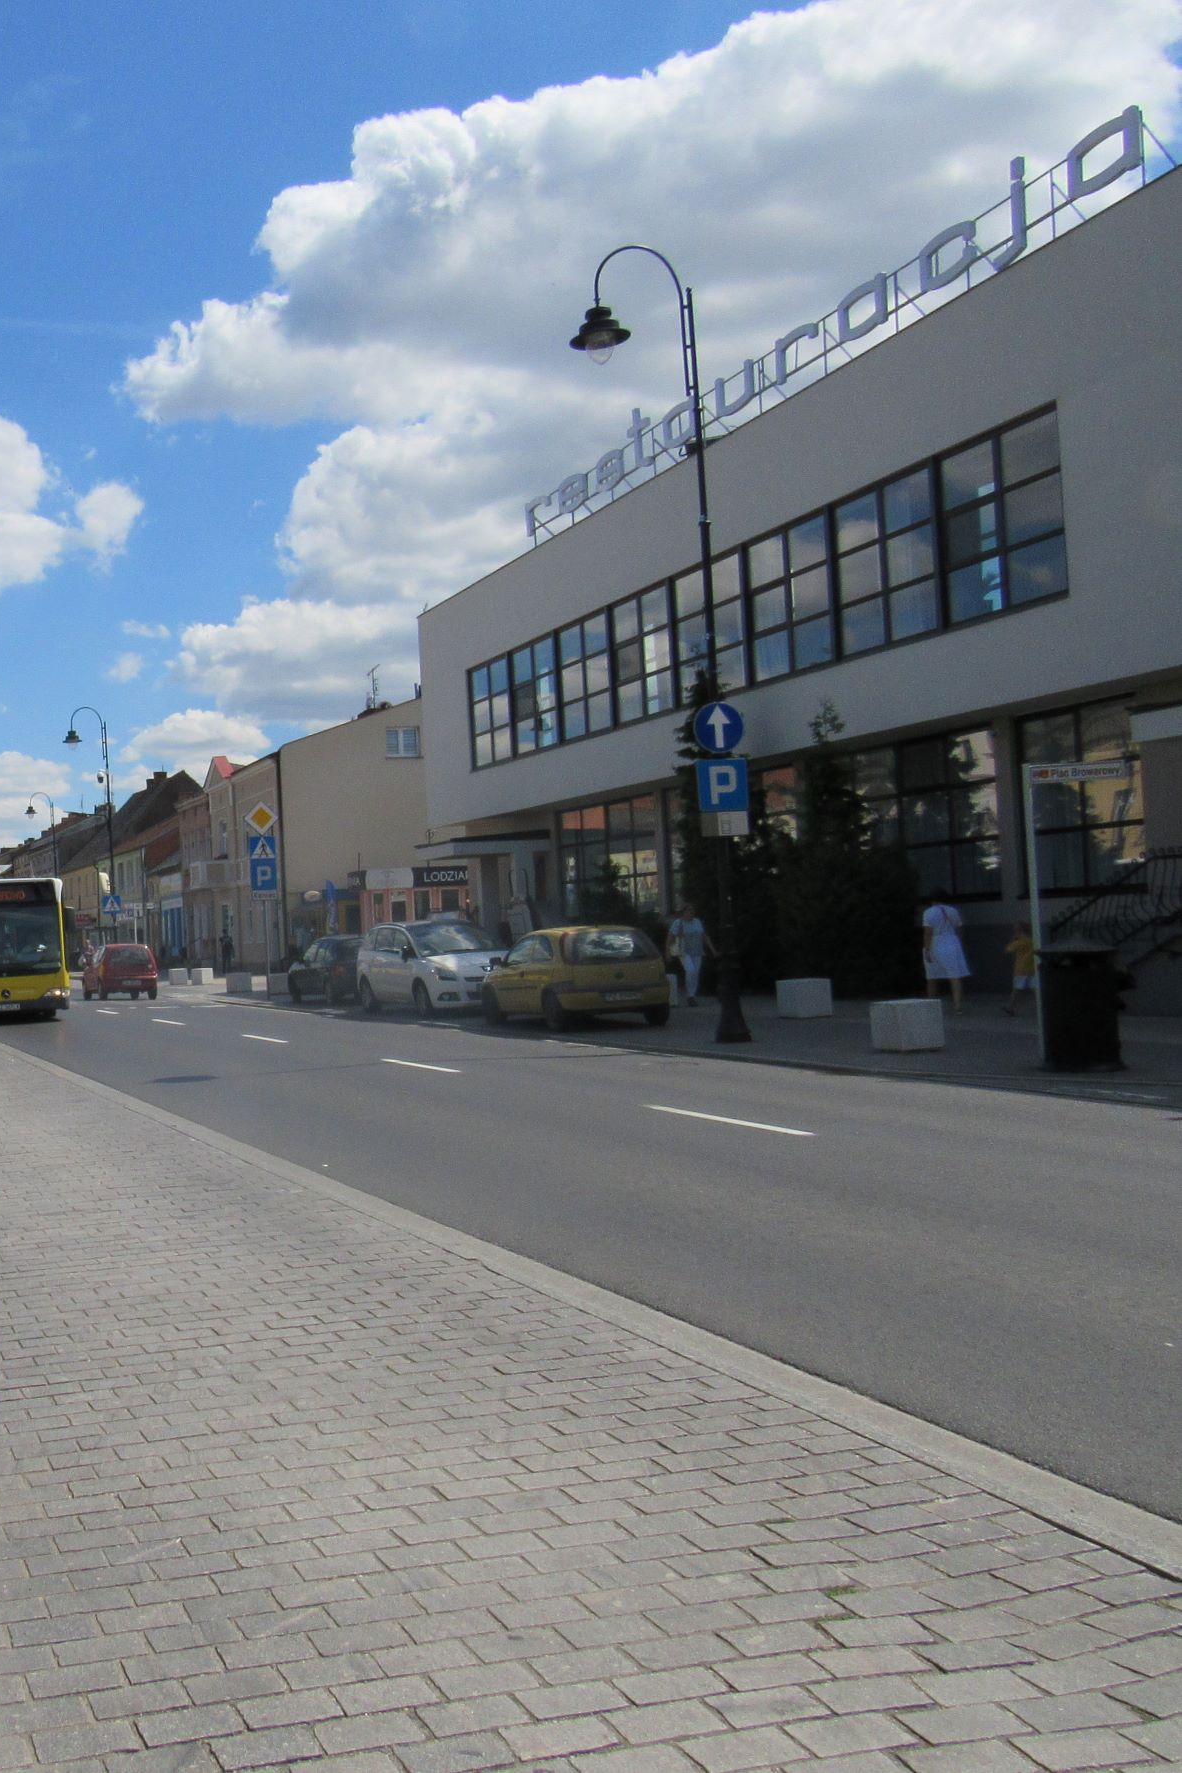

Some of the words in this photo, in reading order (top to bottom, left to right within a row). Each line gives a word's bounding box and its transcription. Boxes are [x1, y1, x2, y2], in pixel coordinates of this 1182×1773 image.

[525, 105, 1141, 537] restauracja
[708, 765, 737, 805] P
[256, 865, 272, 887] P
[423, 870, 468, 883] LODZIA
